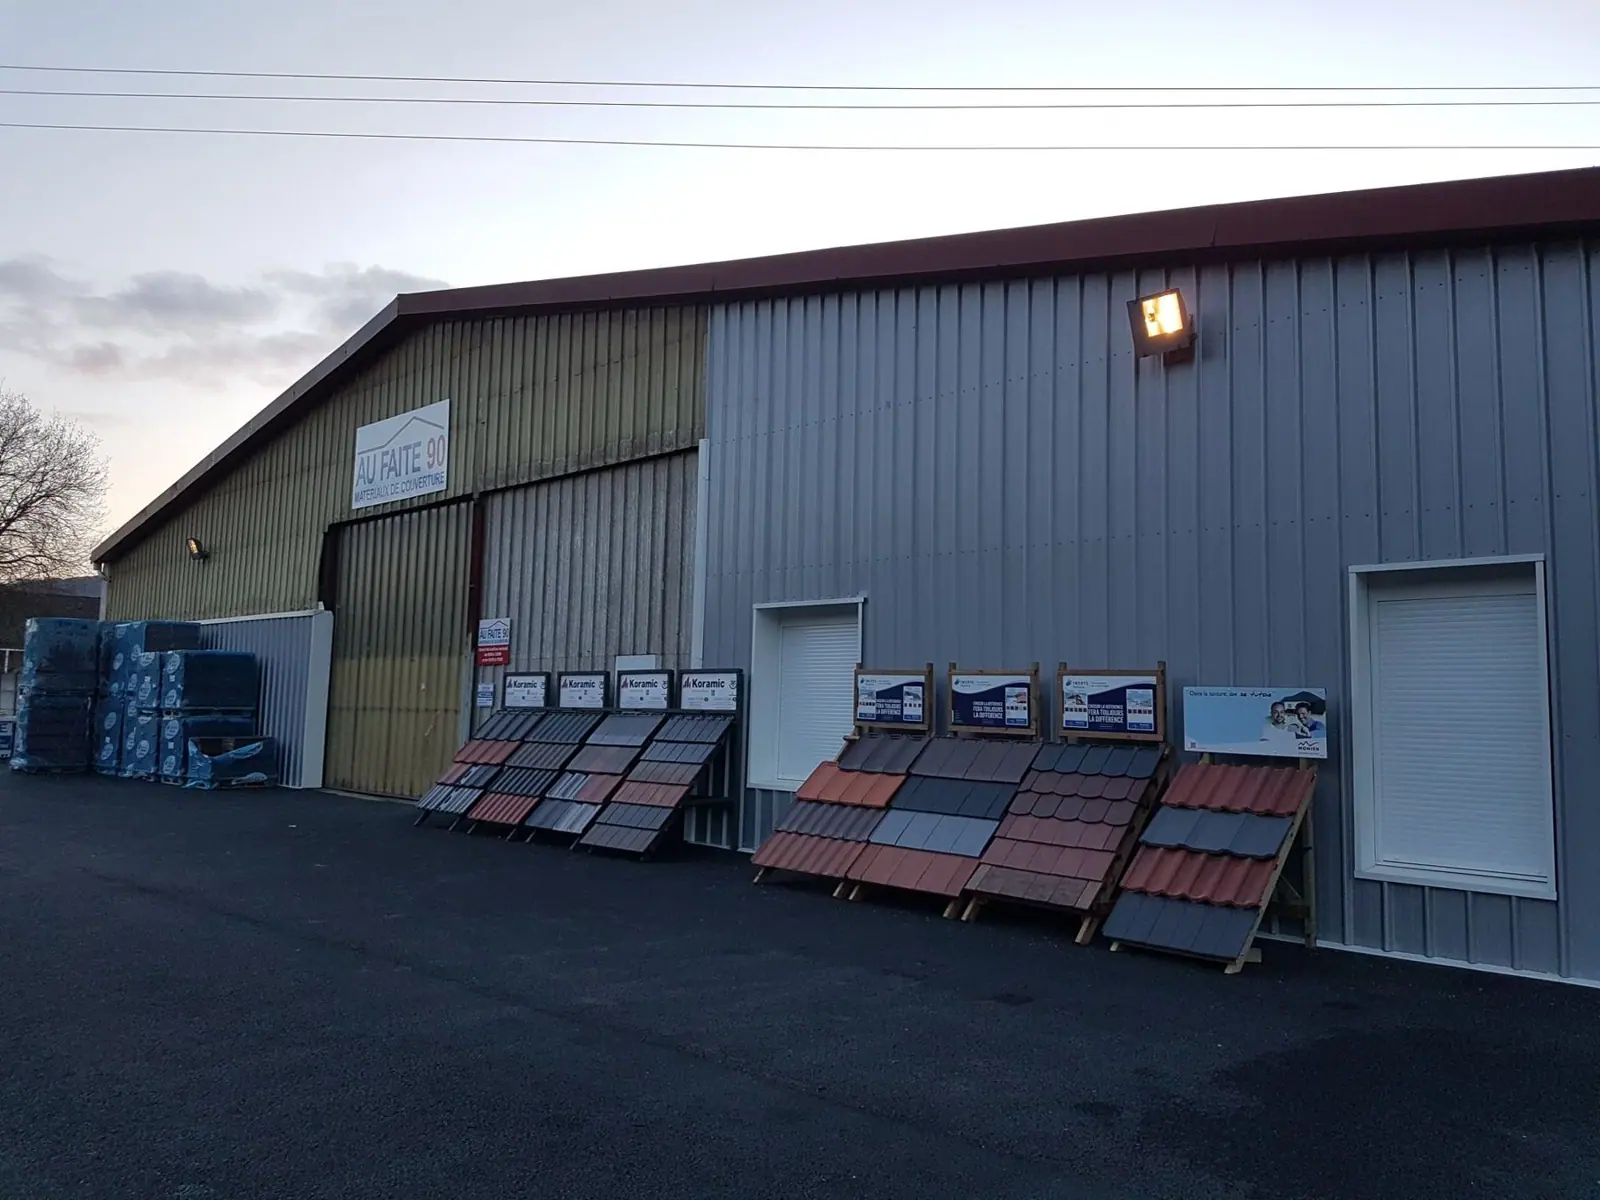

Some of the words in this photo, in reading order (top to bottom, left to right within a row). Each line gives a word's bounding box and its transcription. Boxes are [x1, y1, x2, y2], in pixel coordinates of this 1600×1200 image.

[356, 453, 377, 488] AU
[381, 441, 422, 482] FAITE
[427, 434, 446, 470] 90
[390, 483, 400, 496] DE
[401, 472, 445, 493] COUVERTURE
[513, 679, 538, 689] Koramic
[568, 679, 596, 689] Koramic
[629, 678, 659, 688] Koramic
[692, 678, 725, 688] Koramic
[1088, 715, 1095, 723] LA
